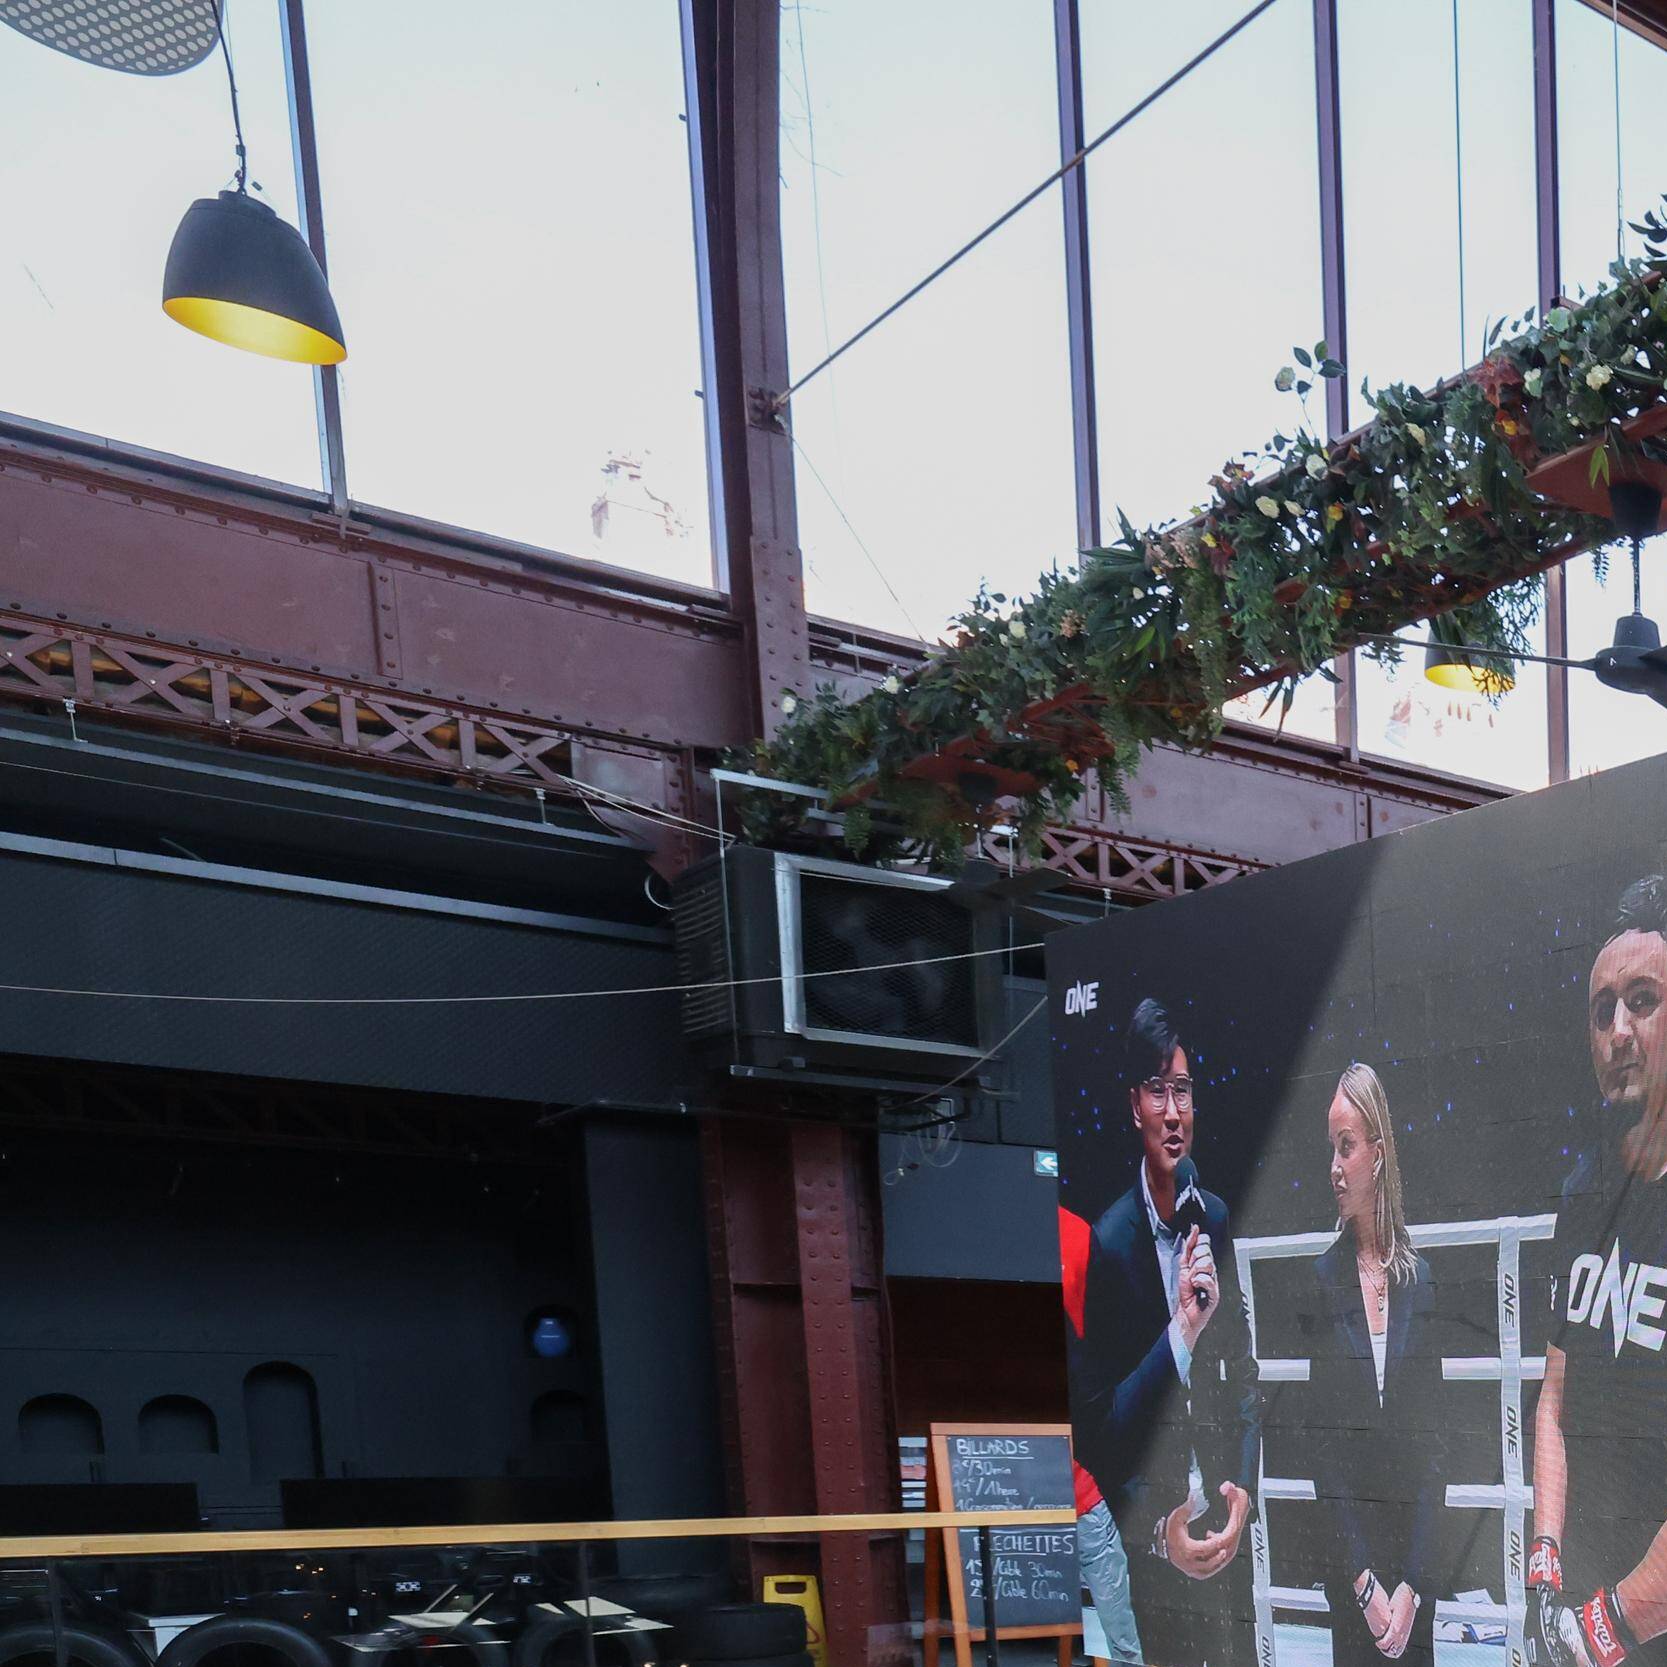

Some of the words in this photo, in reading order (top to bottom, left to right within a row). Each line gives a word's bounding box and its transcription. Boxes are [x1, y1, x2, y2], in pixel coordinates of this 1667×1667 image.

[1065, 979, 1099, 1018] ONE
[1500, 1272, 1515, 1329] ONE
[956, 1438, 1031, 1456] BILLARDS
[1505, 1404, 1519, 1460] ONE
[973, 1535, 1075, 1555] FECHETTES
[1253, 1526, 1266, 1574] ONE
[1509, 1529, 1522, 1582] ONE
